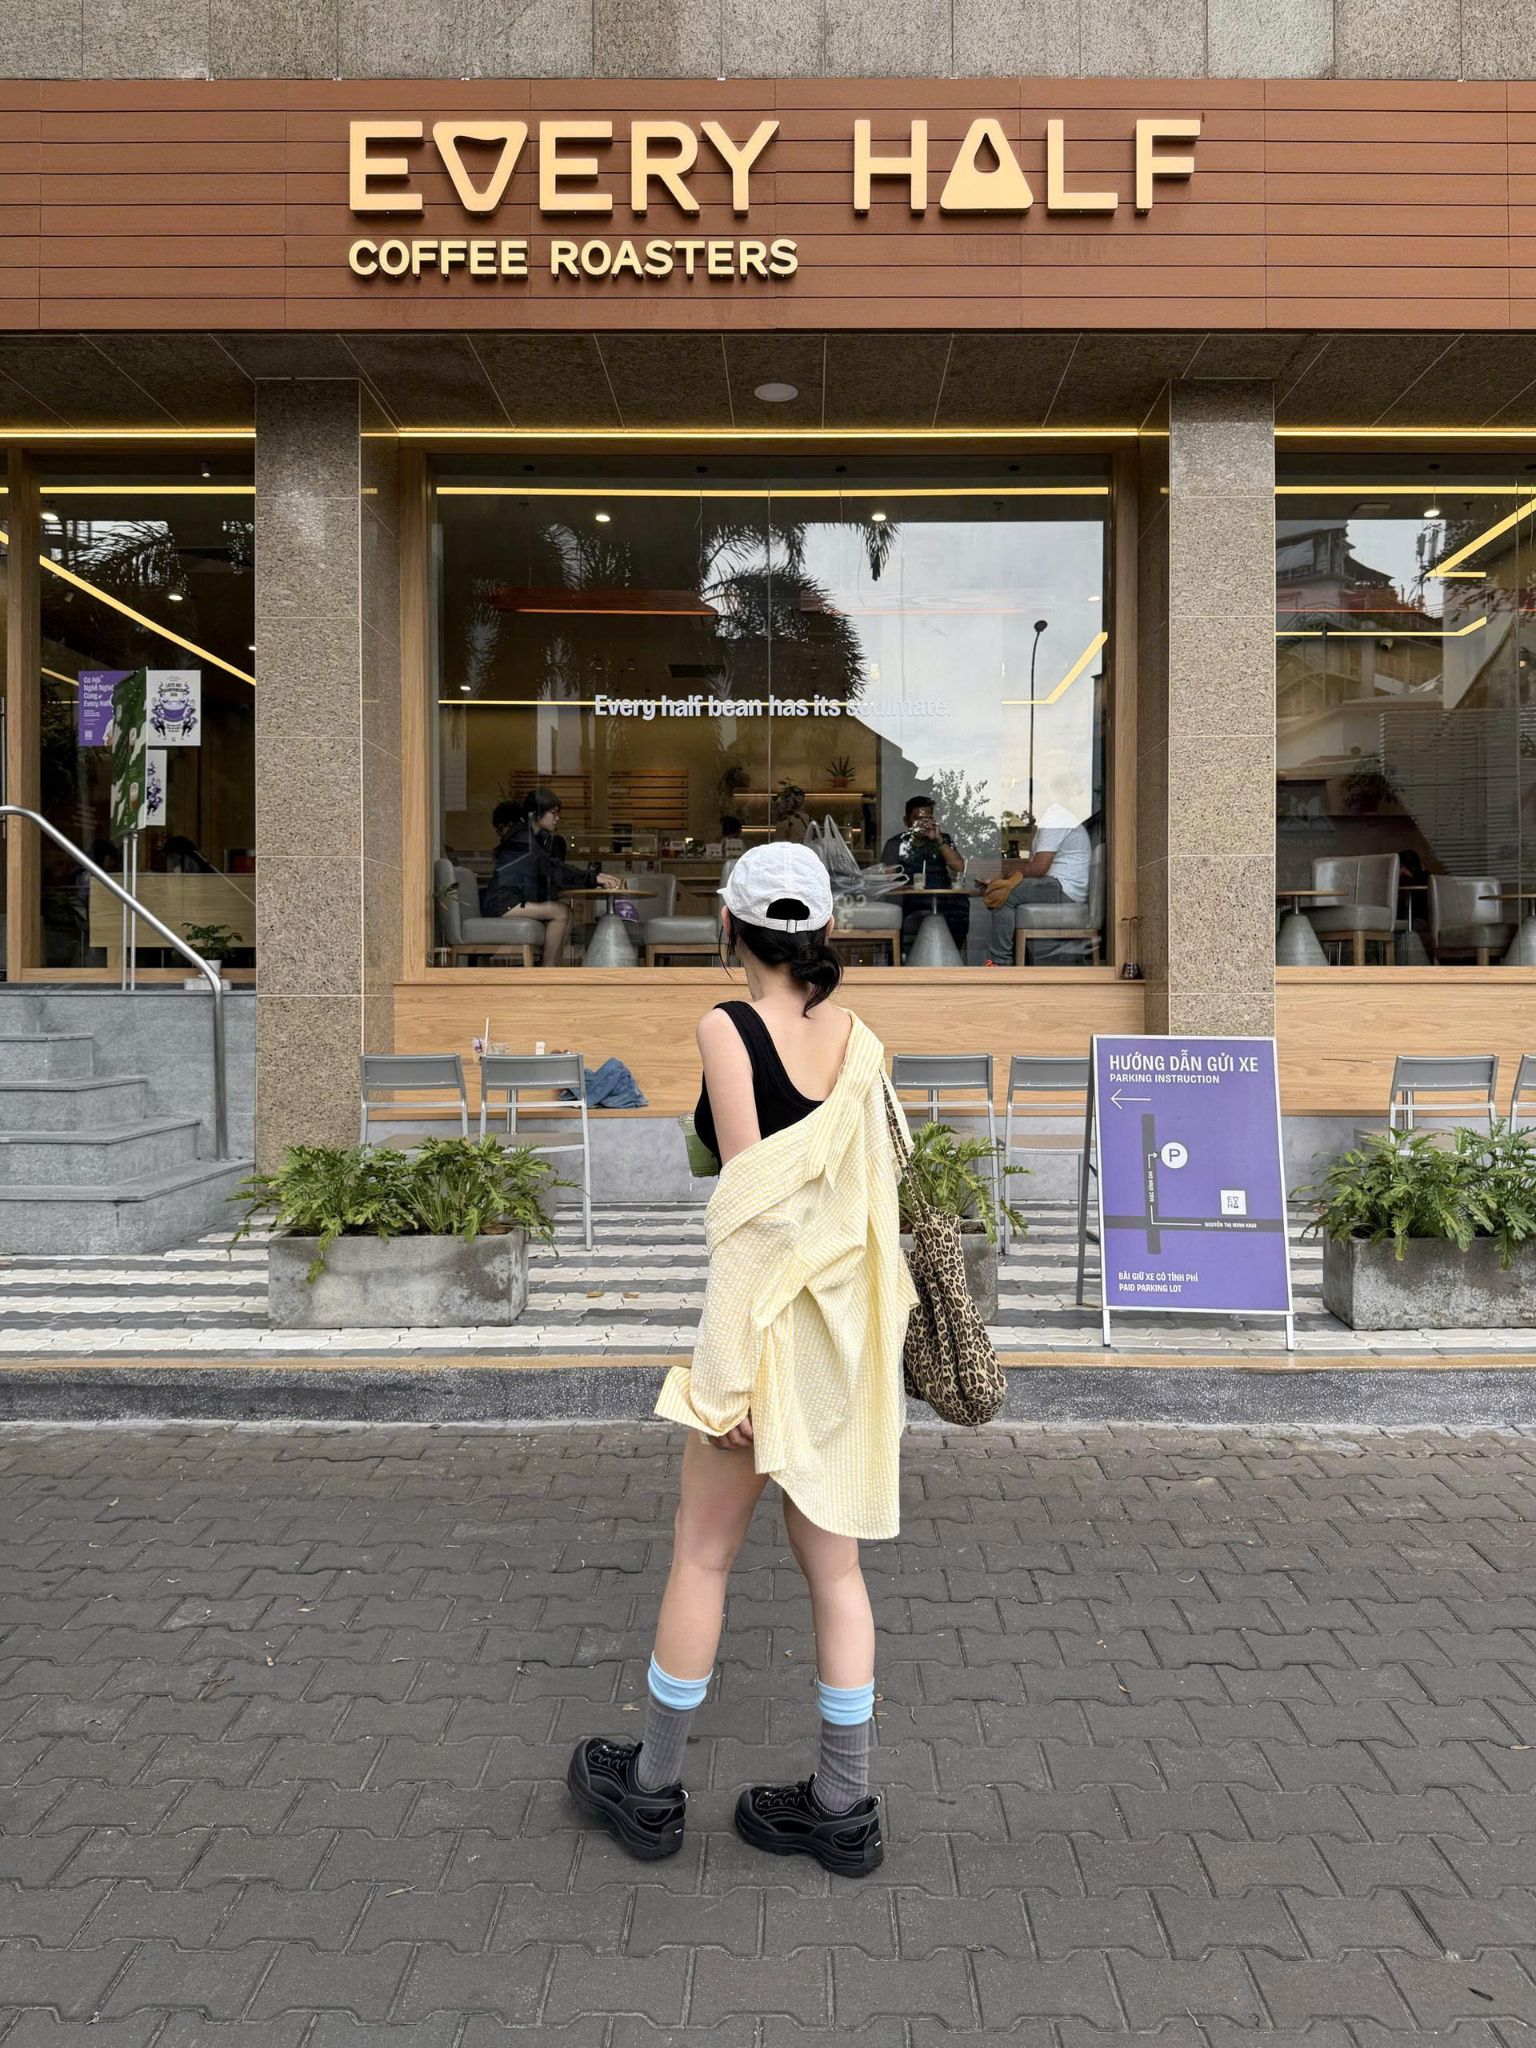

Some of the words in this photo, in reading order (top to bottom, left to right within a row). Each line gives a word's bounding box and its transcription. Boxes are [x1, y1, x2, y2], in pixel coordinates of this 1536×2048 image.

[349, 119, 779, 215] EVERY
[853, 118, 1201, 215] HALF
[348, 239, 529, 279] COFFEE
[550, 239, 799, 279] ROASTERS
[595, 695, 656, 721] Every
[661, 695, 704, 717] half
[708, 695, 763, 717] bean
[769, 695, 809, 717] has
[813, 696, 842, 717] its
[1109, 1051, 1165, 1071] HƯỚNG
[1170, 1049, 1202, 1072] DẪN
[1207, 1052, 1234, 1072] GỬI
[1239, 1057, 1259, 1072] XE
[1110, 1073, 1152, 1083] PARKING
[1155, 1074, 1220, 1084] INSTRUCTION
[1168, 1148, 1181, 1162] P
[1118, 1270, 1131, 1280] BÃI
[1132, 1271, 1145, 1281] GIỮ
[1145, 1272, 1155, 1281] XE
[1167, 1271, 1185, 1282] TÍNH
[1185, 1272, 1199, 1282] PHÍ
[1119, 1283, 1136, 1292] PAID
[1136, 1283, 1168, 1293] PARKING
[1169, 1284, 1182, 1293] LOT
